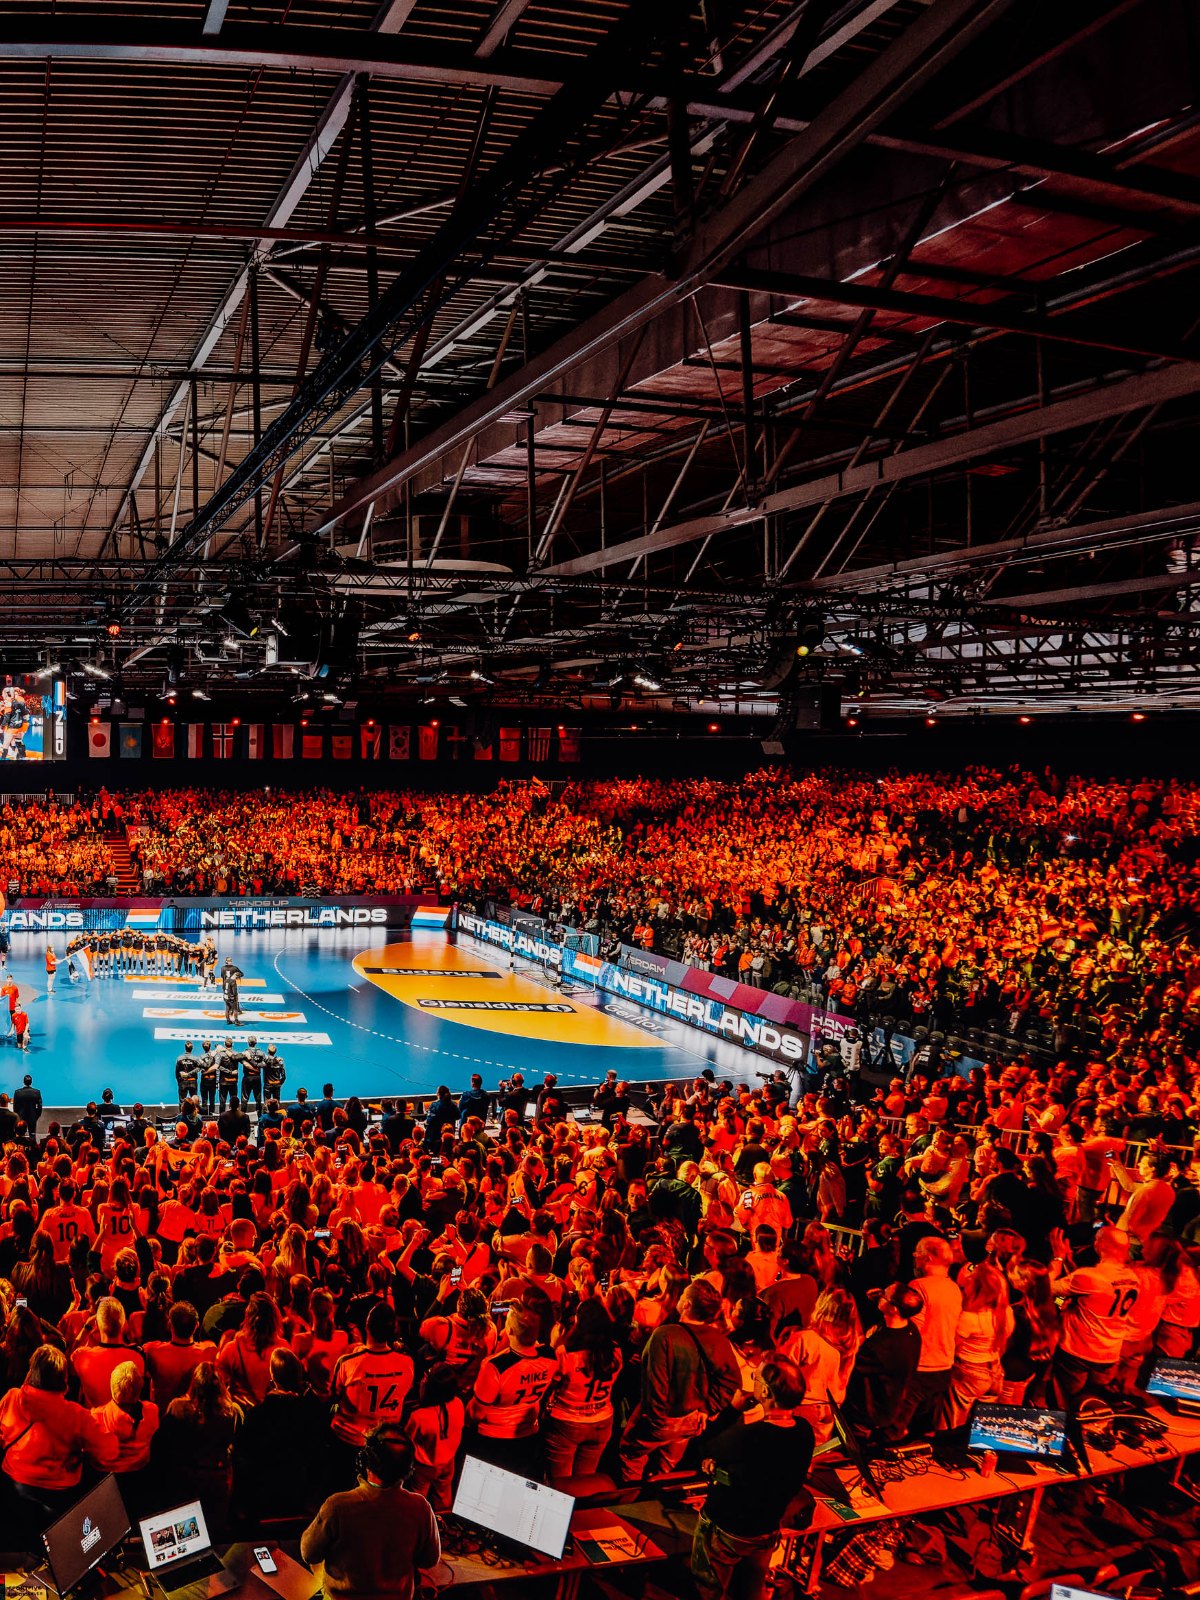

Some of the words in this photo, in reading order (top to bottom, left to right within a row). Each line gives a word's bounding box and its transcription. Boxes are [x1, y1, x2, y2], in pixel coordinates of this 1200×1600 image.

[201, 908, 388, 925] NETHERLANDS
[459, 913, 562, 964] NETHERLANDS
[381, 968, 485, 978] Buderus
[420, 999, 543, 1012] Gjensidige
[614, 970, 803, 1059] NETHERLANDS
[604, 1003, 664, 1033] Gerflor
[170, 1033, 288, 1042] GRUNDOS
[57, 1221, 79, 1242] 10
[111, 1215, 132, 1235] 10
[1107, 1288, 1138, 1318] 10
[519, 1371, 548, 1385] MIKE
[367, 1384, 399, 1413] 14
[583, 1378, 611, 1403] 15
